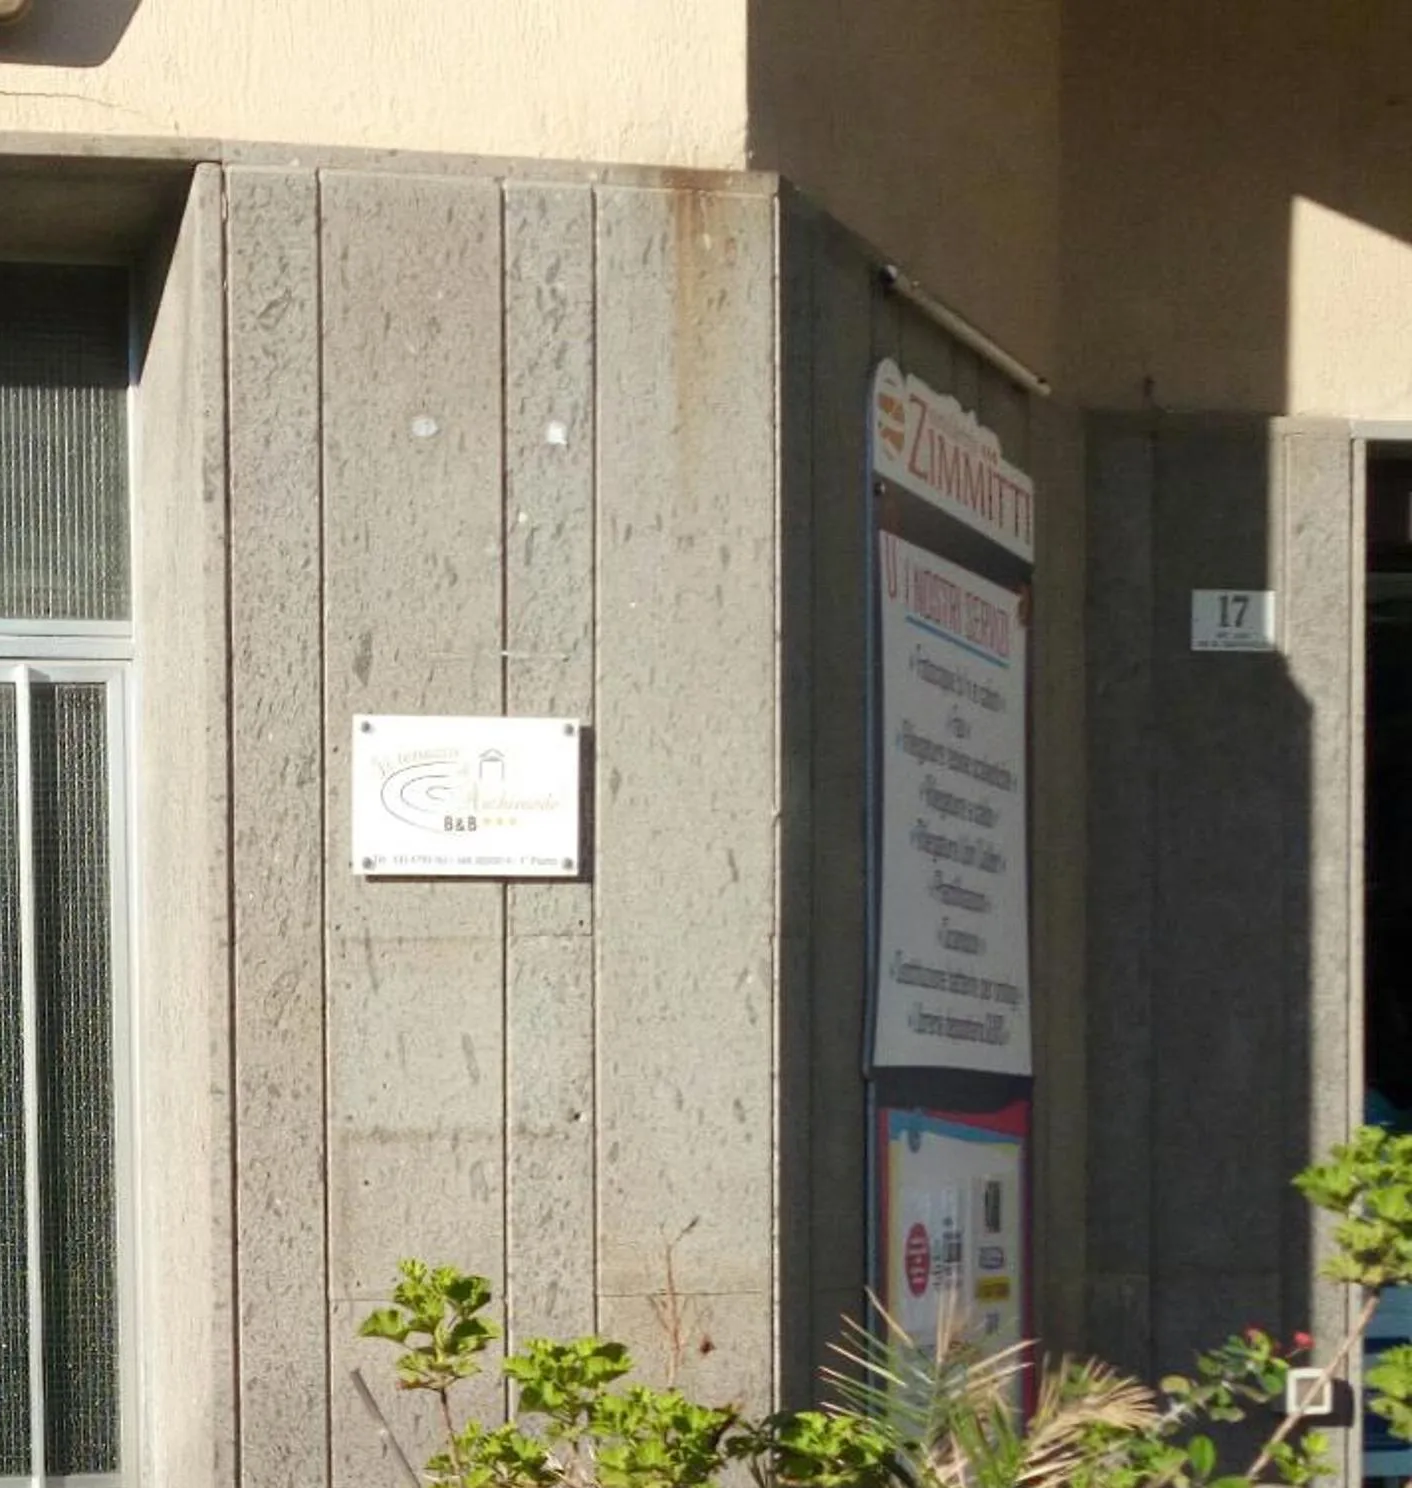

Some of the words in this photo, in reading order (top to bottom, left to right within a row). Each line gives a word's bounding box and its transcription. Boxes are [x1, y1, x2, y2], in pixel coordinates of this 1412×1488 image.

[908, 393, 1031, 546] ZIMMITTI
[1219, 595, 1249, 628] 17
[444, 815, 477, 832] B&B
